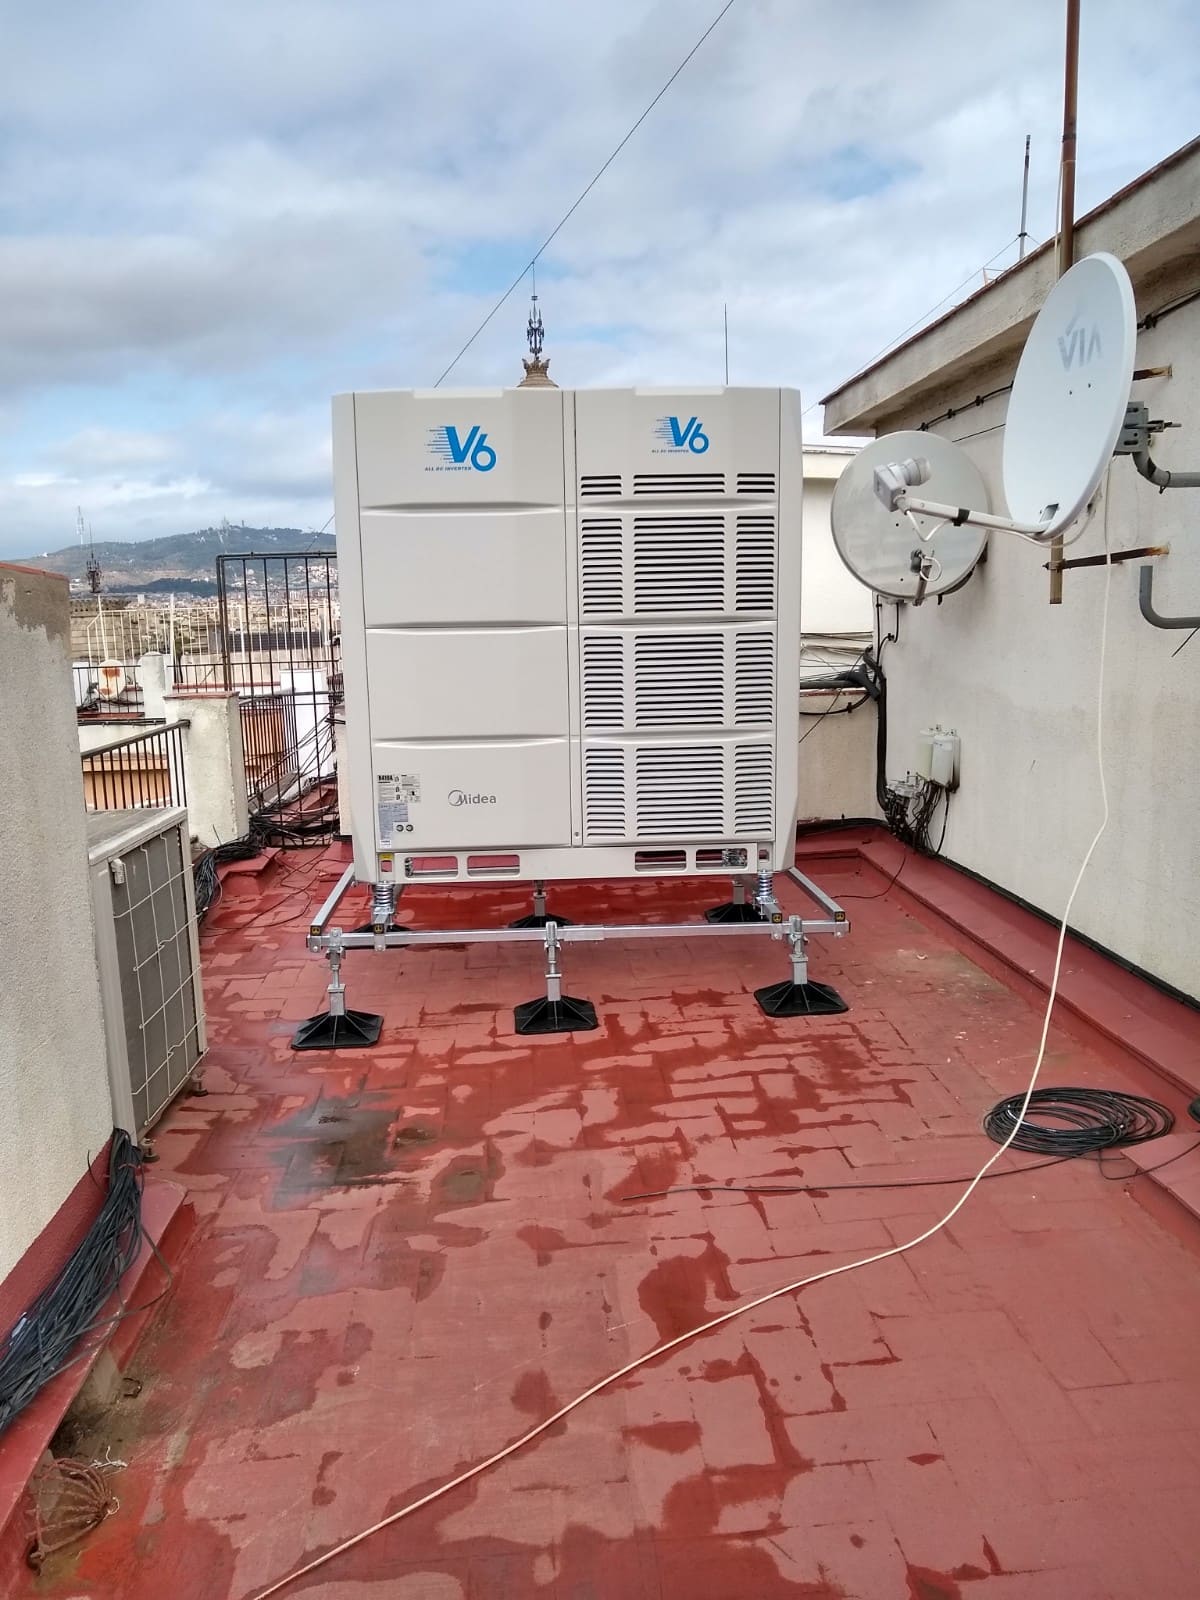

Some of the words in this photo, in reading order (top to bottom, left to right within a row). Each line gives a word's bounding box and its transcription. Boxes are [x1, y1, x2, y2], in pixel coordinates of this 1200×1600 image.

[445, 425, 497, 472] V6
[669, 416, 710, 454] V6
[447, 789, 497, 807] Midea
